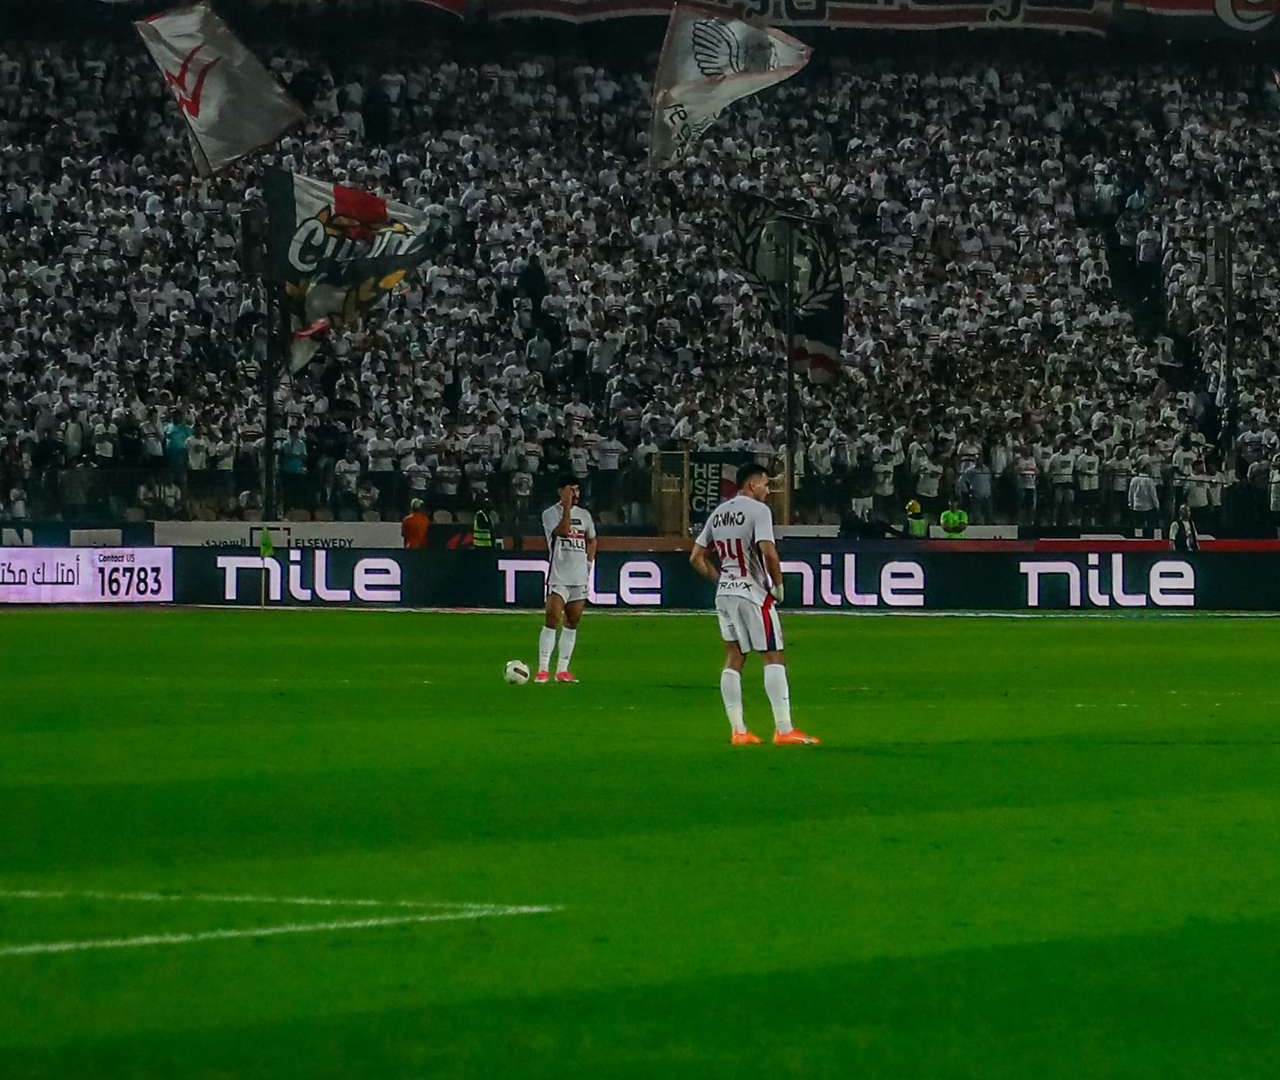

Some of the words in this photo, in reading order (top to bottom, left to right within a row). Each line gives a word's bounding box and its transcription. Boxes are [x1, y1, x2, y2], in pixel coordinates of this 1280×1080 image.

[98, 553, 125, 563] Contact
[98, 566, 162, 596] 16783
[215, 547, 402, 602] nile
[497, 556, 662, 606] nle
[1018, 551, 1196, 607] nile
